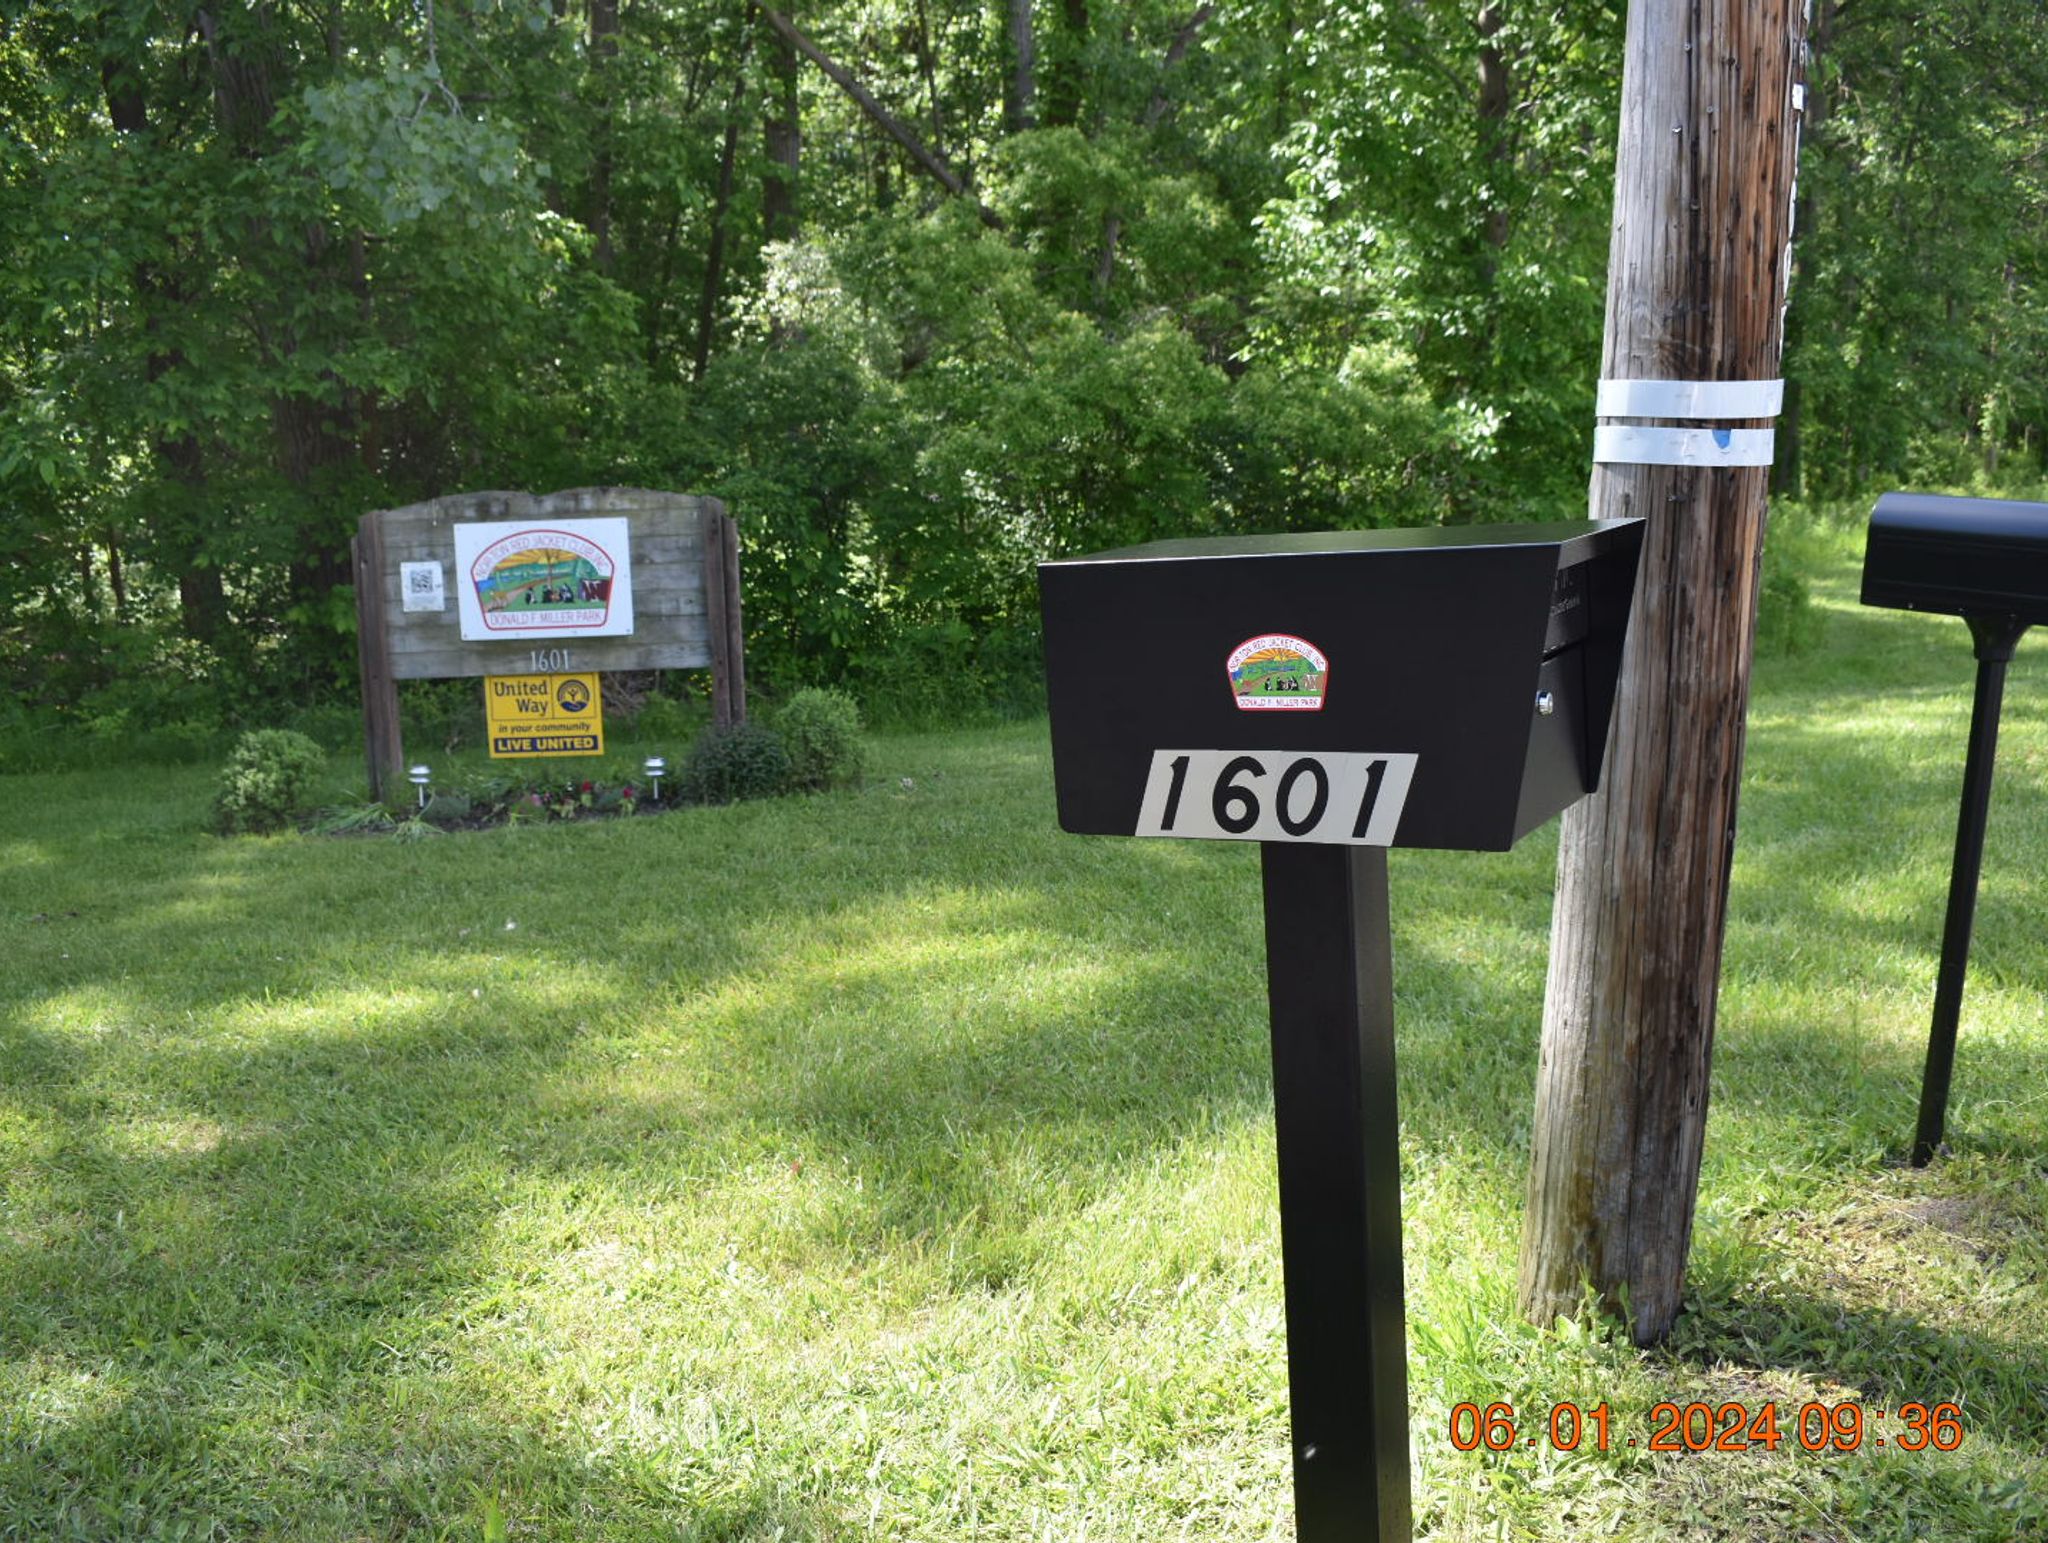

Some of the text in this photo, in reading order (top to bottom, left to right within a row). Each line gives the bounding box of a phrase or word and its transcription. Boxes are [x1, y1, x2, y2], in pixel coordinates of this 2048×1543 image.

[511, 536, 529, 550] RED
[533, 534, 567, 549] JACKET
[491, 612, 529, 626] DONALD
[540, 610, 575, 624] MILLER
[576, 608, 602, 622] PARK
[530, 649, 569, 673] 1601
[494, 679, 548, 697] United
[516, 698, 548, 716] Way
[499, 722, 591, 735] in your community
[498, 736, 594, 751] LIVE UNITED
[1160, 755, 1388, 839] 1601
